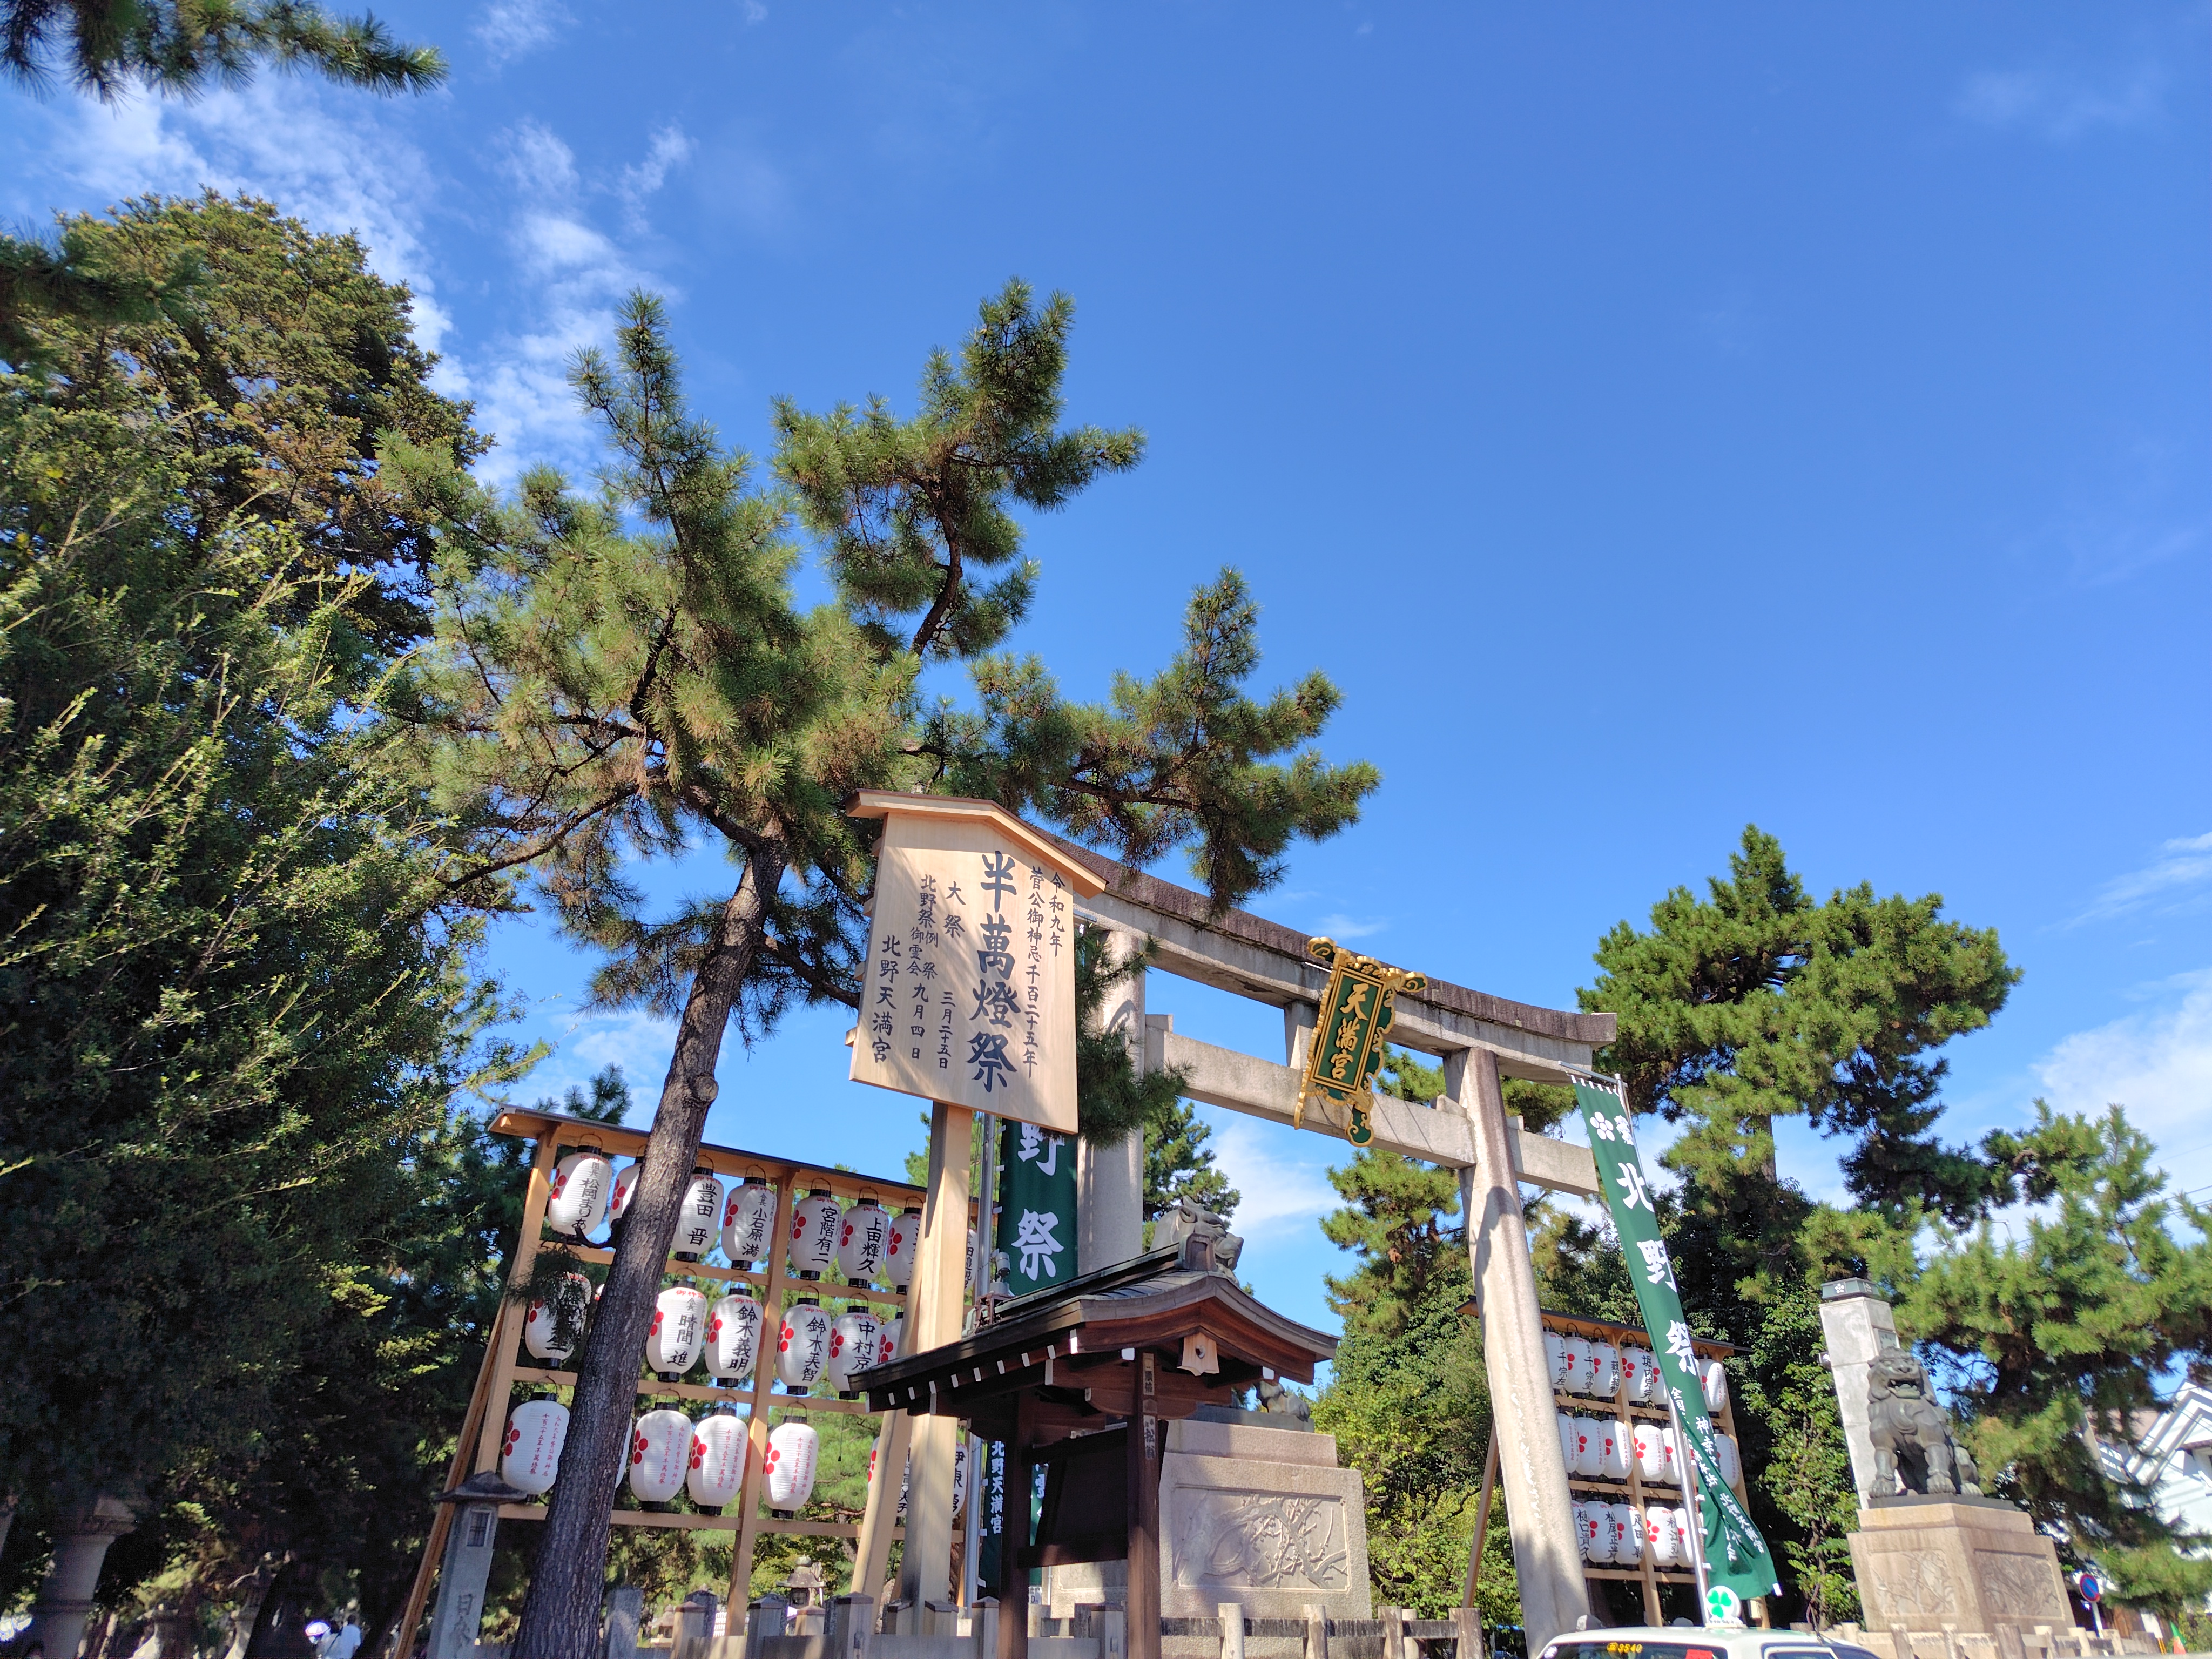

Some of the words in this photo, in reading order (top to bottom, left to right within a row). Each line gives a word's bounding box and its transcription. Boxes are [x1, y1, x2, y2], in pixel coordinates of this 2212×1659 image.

[918, 874, 936, 928] 北野祭
[944, 880, 966, 939] 大祭
[1050, 871, 1066, 957] 令和九年
[872, 935, 901, 1063] 北野天満宮
[967, 850, 1021, 1093] 半萬燈祭
[1022, 866, 1044, 1078] 菅公御神忌千百二十五年
[937, 992, 956, 1069] 三月二十五日
[1330, 983, 1369, 1080] 天満宮
[811, 1206, 838, 1264] 宮階有二
[857, 1217, 882, 1274] 上田輝久
[1617, 1162, 1697, 1376] 北野祭
[727, 1305, 758, 1373] 鈴木義明
[990, 1441, 1004, 1534] 北野天満宮
